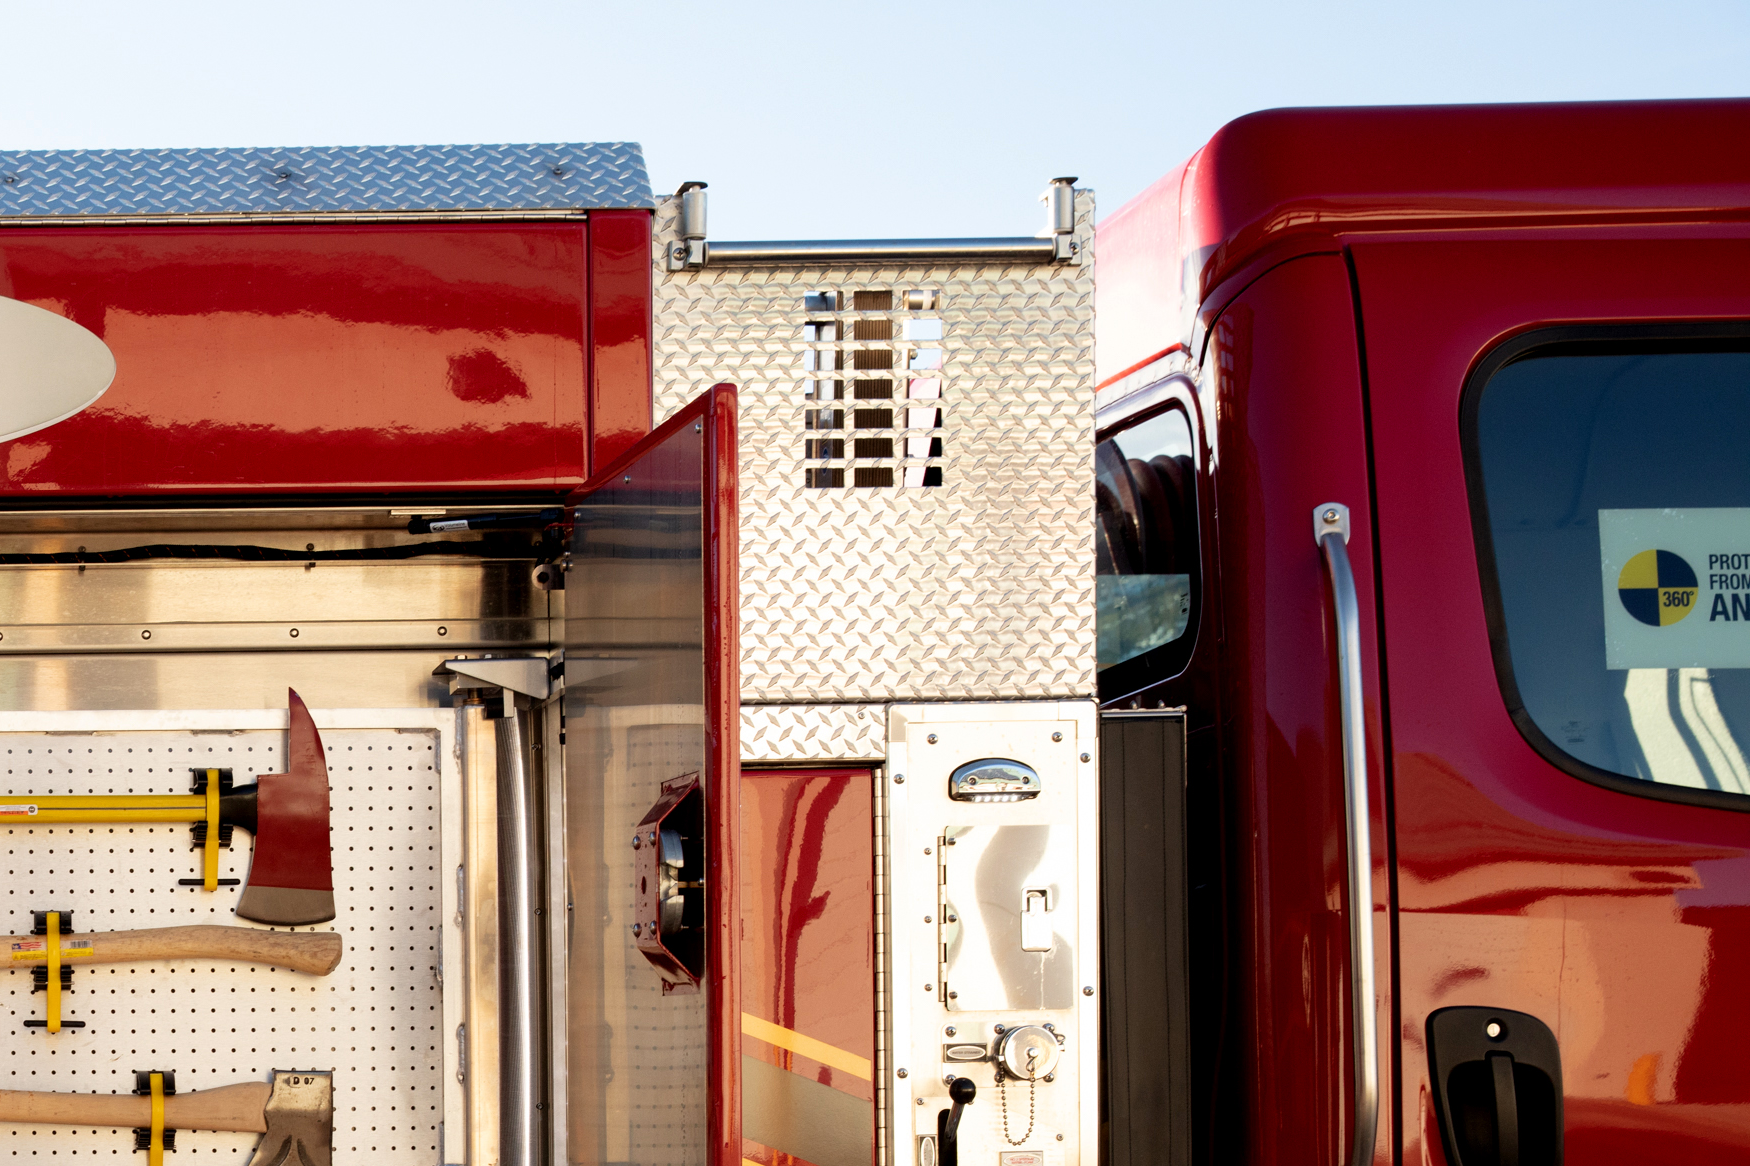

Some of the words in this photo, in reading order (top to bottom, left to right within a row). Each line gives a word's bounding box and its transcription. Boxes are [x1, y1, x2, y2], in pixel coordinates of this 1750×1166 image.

[1662, 590, 1695, 608] 360°
[1709, 592, 1750, 622] AN
[303, 1077, 315, 1085] 07
